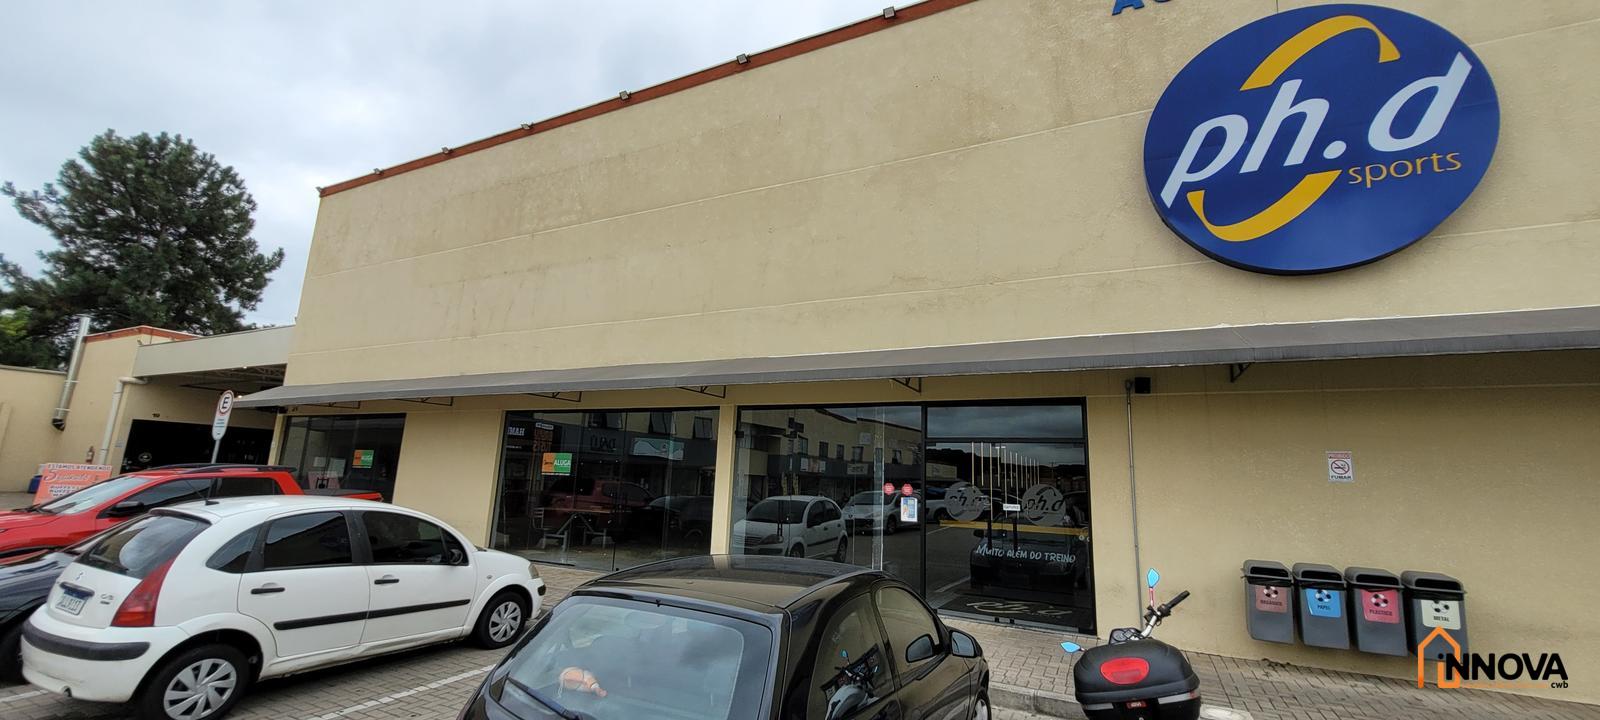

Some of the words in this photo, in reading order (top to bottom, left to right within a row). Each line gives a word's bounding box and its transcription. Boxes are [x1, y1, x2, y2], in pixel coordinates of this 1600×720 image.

[1160, 51, 1473, 209] ph.d
[1348, 152, 1462, 188] sports
[222, 396, 230, 408] E
[975, 543, 1004, 558] MUITO
[1006, 546, 1028, 559] ALÉM
[1030, 551, 1042, 560] DO
[1044, 552, 1077, 563] TREINO
